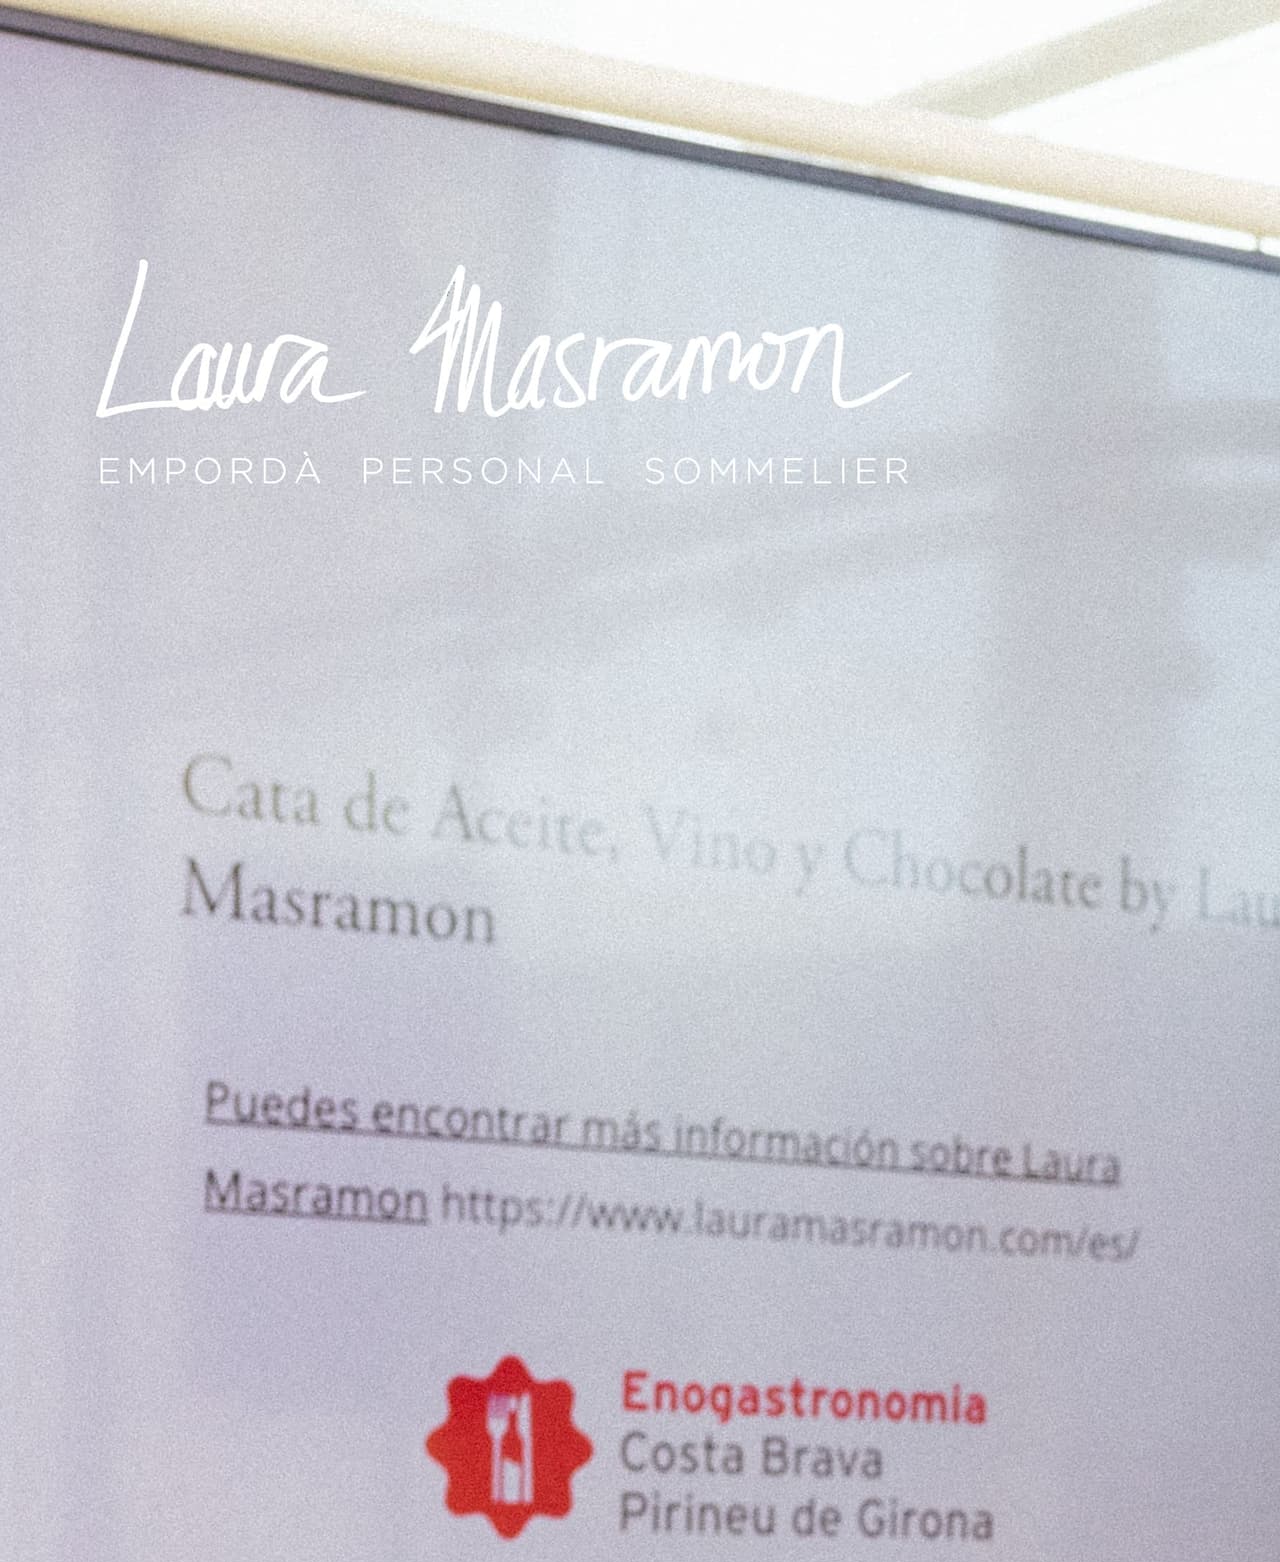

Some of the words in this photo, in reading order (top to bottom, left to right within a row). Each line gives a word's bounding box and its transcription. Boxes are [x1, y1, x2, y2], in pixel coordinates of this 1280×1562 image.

[181, 751, 320, 826] Cata
[343, 767, 409, 835] de
[431, 781, 620, 865] Aceite,
[642, 799, 777, 877] Vino
[793, 839, 824, 897] y
[843, 826, 1101, 911] Chocolate
[1117, 853, 1175, 934] by
[181, 855, 499, 945] Masramon
[205, 1079, 359, 1133] Puedes
[371, 1098, 568, 1144] encontrar
[581, 1110, 662, 1152] más
[675, 1114, 897, 1168] información
[910, 1134, 1012, 1177] sobre
[1022, 1143, 1122, 1185] Laura
[204, 1168, 428, 1222] Masramon
[442, 1180, 1141, 1262] https://www.lauramasramon.com/es/
[620, 1430, 745, 1475] Costa
[761, 1435, 884, 1480] Brava
[619, 1490, 777, 1538] Pirineu
[790, 1497, 842, 1537] de
[857, 1498, 995, 1542] Girona
